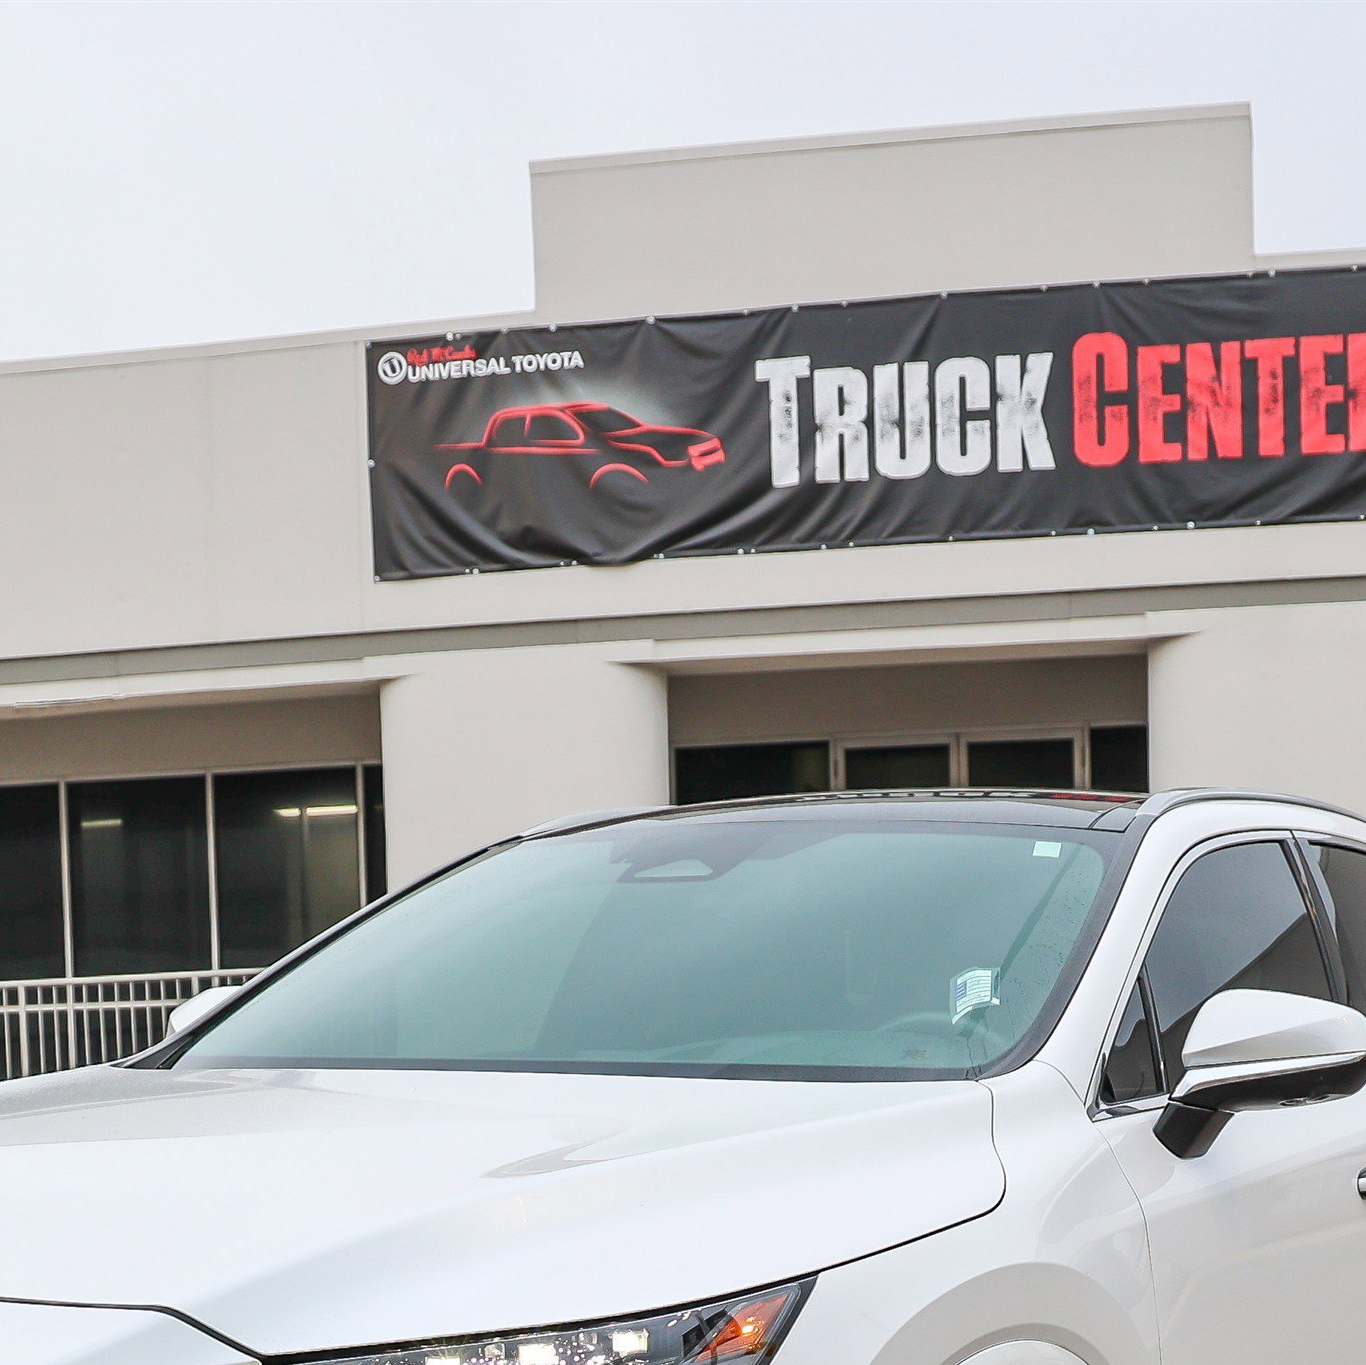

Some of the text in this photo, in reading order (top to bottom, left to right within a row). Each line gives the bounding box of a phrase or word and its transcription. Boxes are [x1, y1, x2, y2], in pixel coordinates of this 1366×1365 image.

[408, 350, 585, 383] UNIVERSAL TOYOTA
[754, 351, 1056, 489] TRUCK
